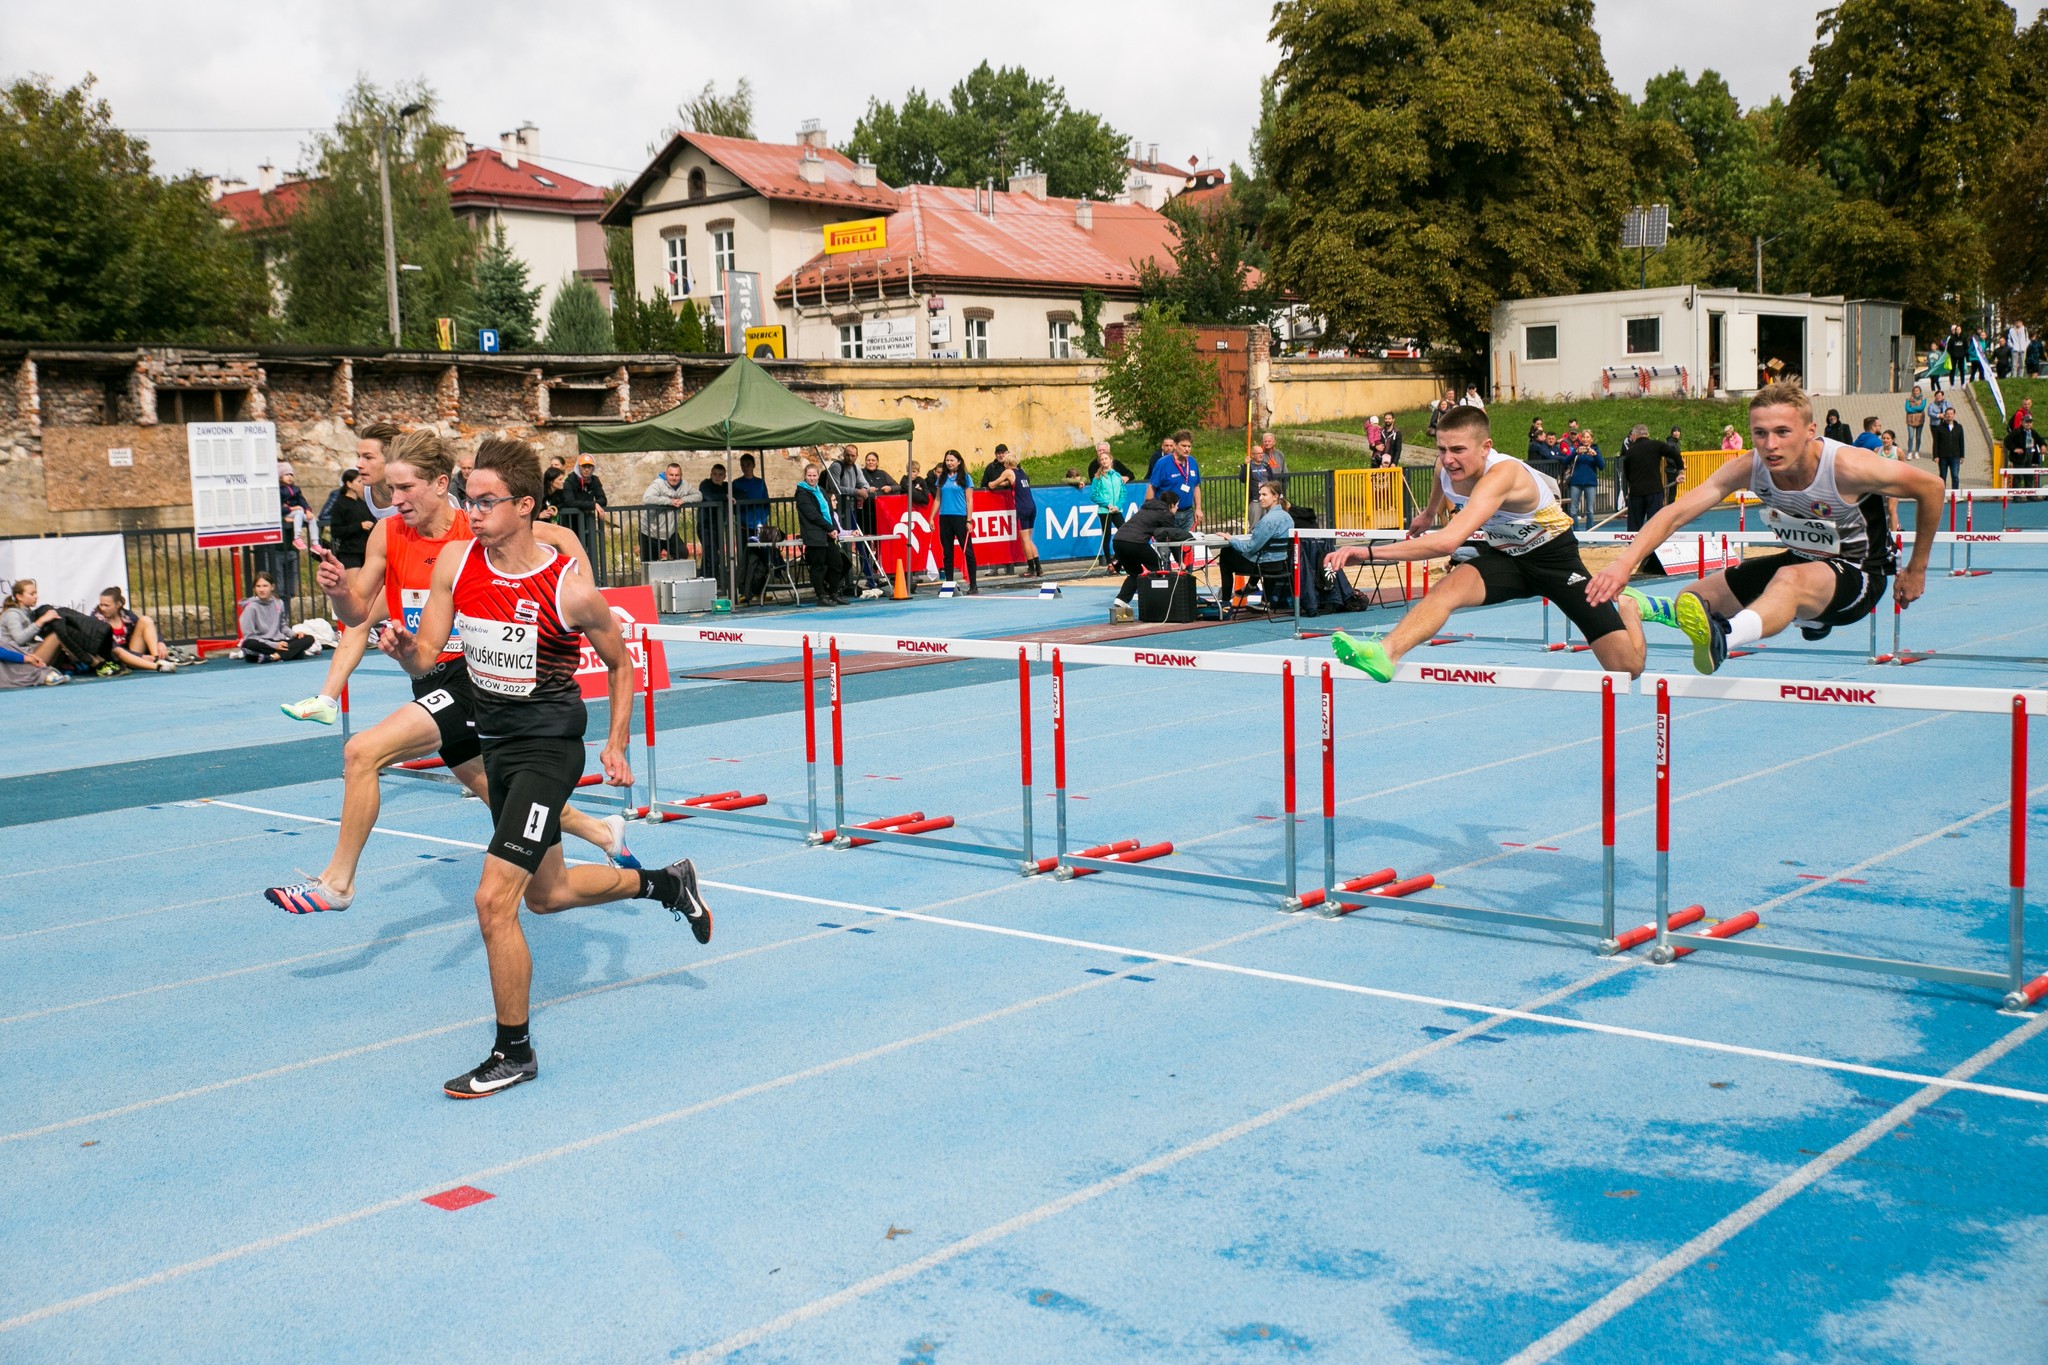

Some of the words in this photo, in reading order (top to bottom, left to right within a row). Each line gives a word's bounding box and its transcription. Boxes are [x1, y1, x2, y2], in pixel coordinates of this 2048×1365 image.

[830, 226, 877, 246] PIRELLI
[483, 331, 495, 352] P
[866, 336, 913, 344] PROFESJONALNY
[887, 343, 913, 351] WYMIANY
[196, 426, 234, 436] ZAWODNIK
[224, 476, 247, 485] WYNIK
[971, 515, 1013, 539] RLEN
[1803, 520, 1827, 530] 48
[1956, 534, 2001, 542] POLANIK
[464, 623, 489, 634] Kraków
[502, 625, 526, 643] 29
[699, 630, 744, 642] POLANIK
[897, 640, 949, 653] POLANIK
[1134, 652, 1197, 667] POLANIK
[1420, 667, 1497, 684] POLANIK
[503, 684, 527, 693] 2022
[1780, 684, 1877, 704] POLANIK
[426, 692, 447, 705] 5
[1656, 715, 1665, 761] POLANIK
[530, 809, 540, 834] 4
[503, 841, 534, 856] COLO
